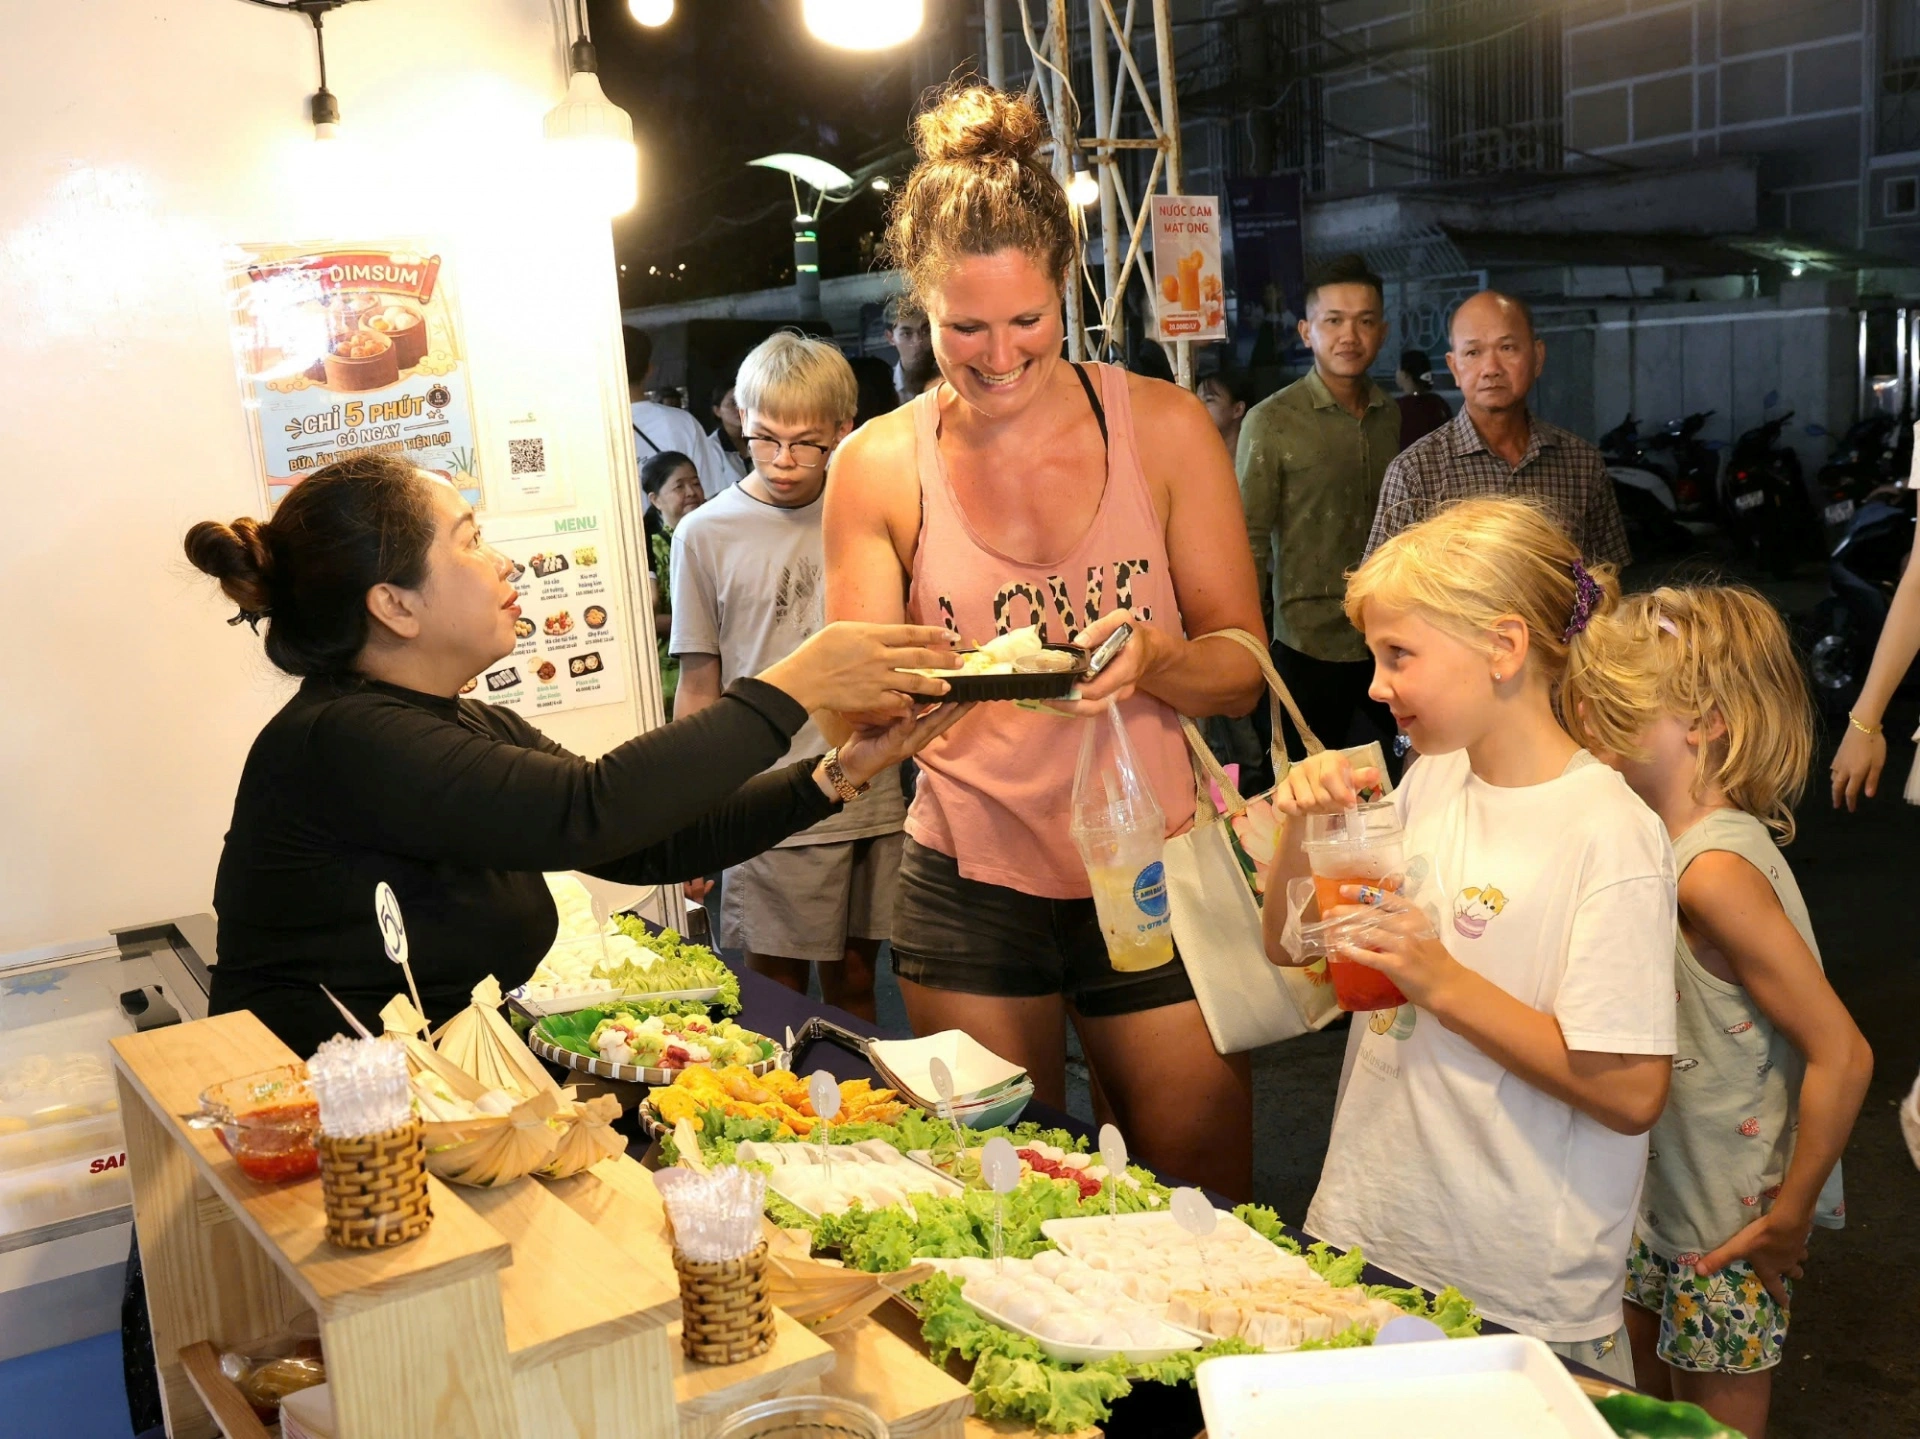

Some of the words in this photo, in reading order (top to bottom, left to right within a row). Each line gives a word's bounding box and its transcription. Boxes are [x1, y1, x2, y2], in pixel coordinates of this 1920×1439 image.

[1189, 206, 1212, 217] CAM
[1187, 222, 1209, 233] ONG
[329, 264, 418, 286] DIMSUM
[303, 404, 341, 434] CHỈ
[344, 401, 364, 427] 5
[369, 394, 426, 423] PHÚT
[336, 427, 358, 447] CÓ
[361, 423, 401, 442] NGAY
[554, 516, 597, 532] MENU
